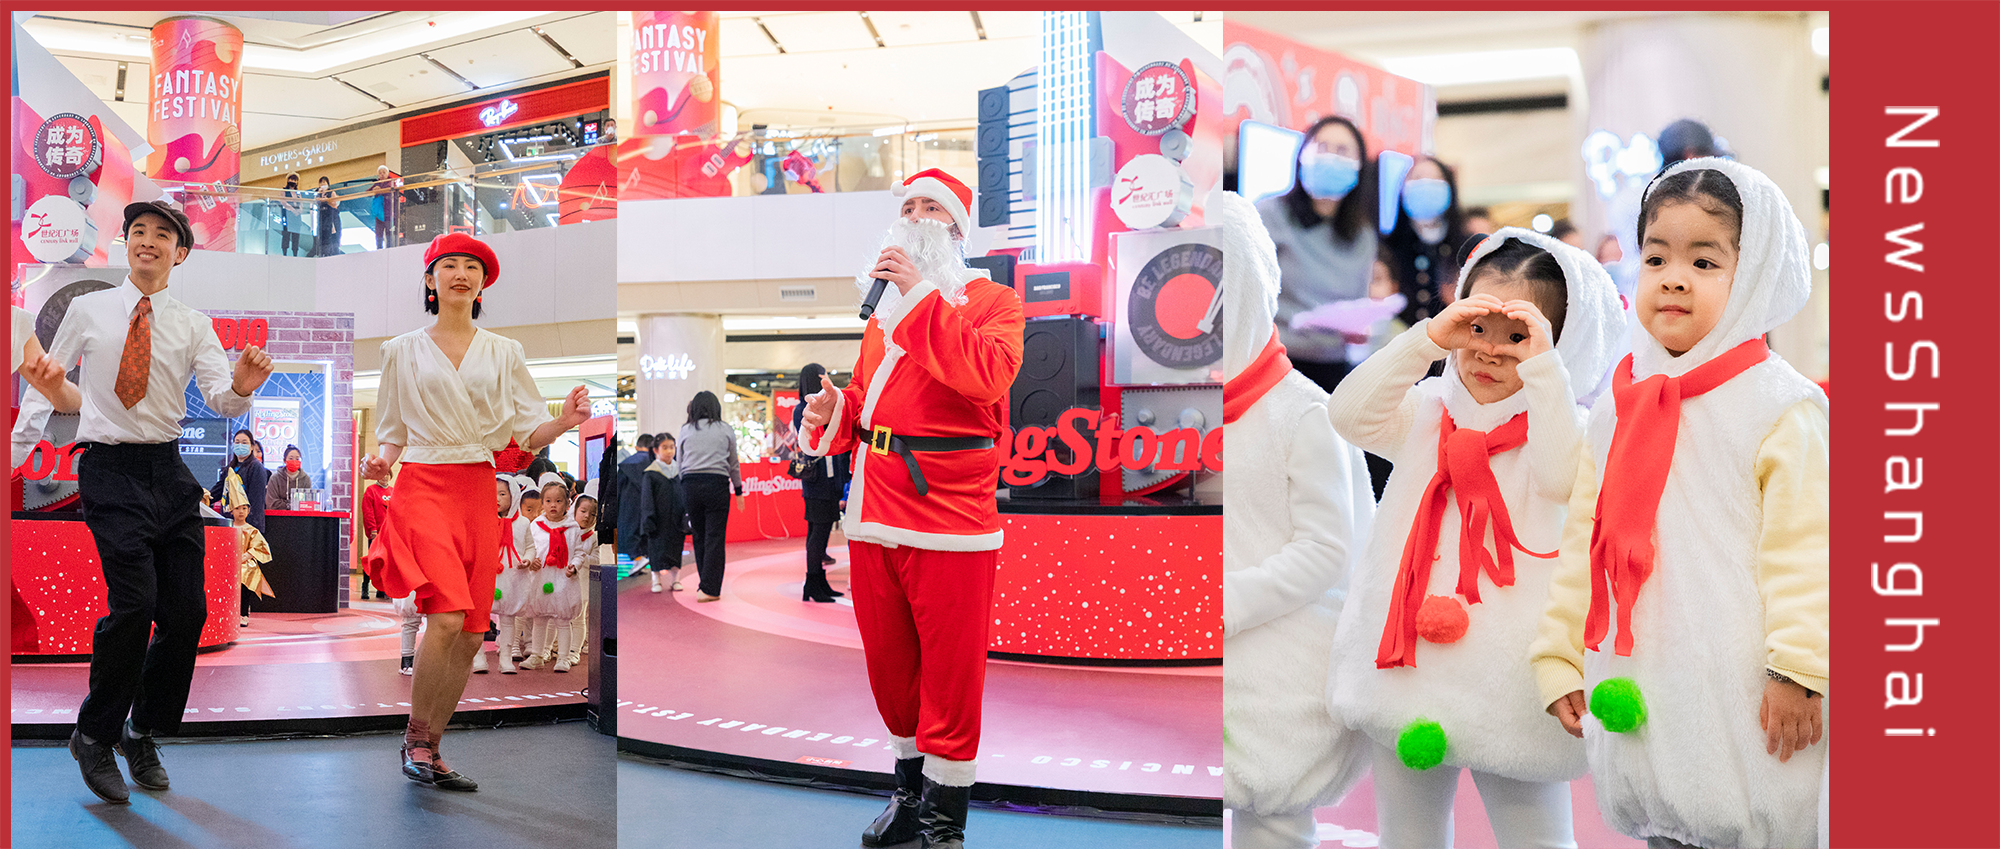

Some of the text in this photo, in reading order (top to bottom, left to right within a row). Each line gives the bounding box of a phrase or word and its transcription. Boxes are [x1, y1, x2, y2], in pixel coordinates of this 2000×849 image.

[154, 69, 239, 103] FANTASY
[1135, 74, 1175, 101] 成为
[153, 96, 238, 126] FESTIVAL
[1134, 96, 1178, 124] 传奇
[46, 125, 84, 145] 成为
[45, 145, 86, 167] 传奇
[41, 229, 79, 238] 世纪汇广场
[1136, 275, 1157, 299] BE
[256, 422, 296, 441] 500
